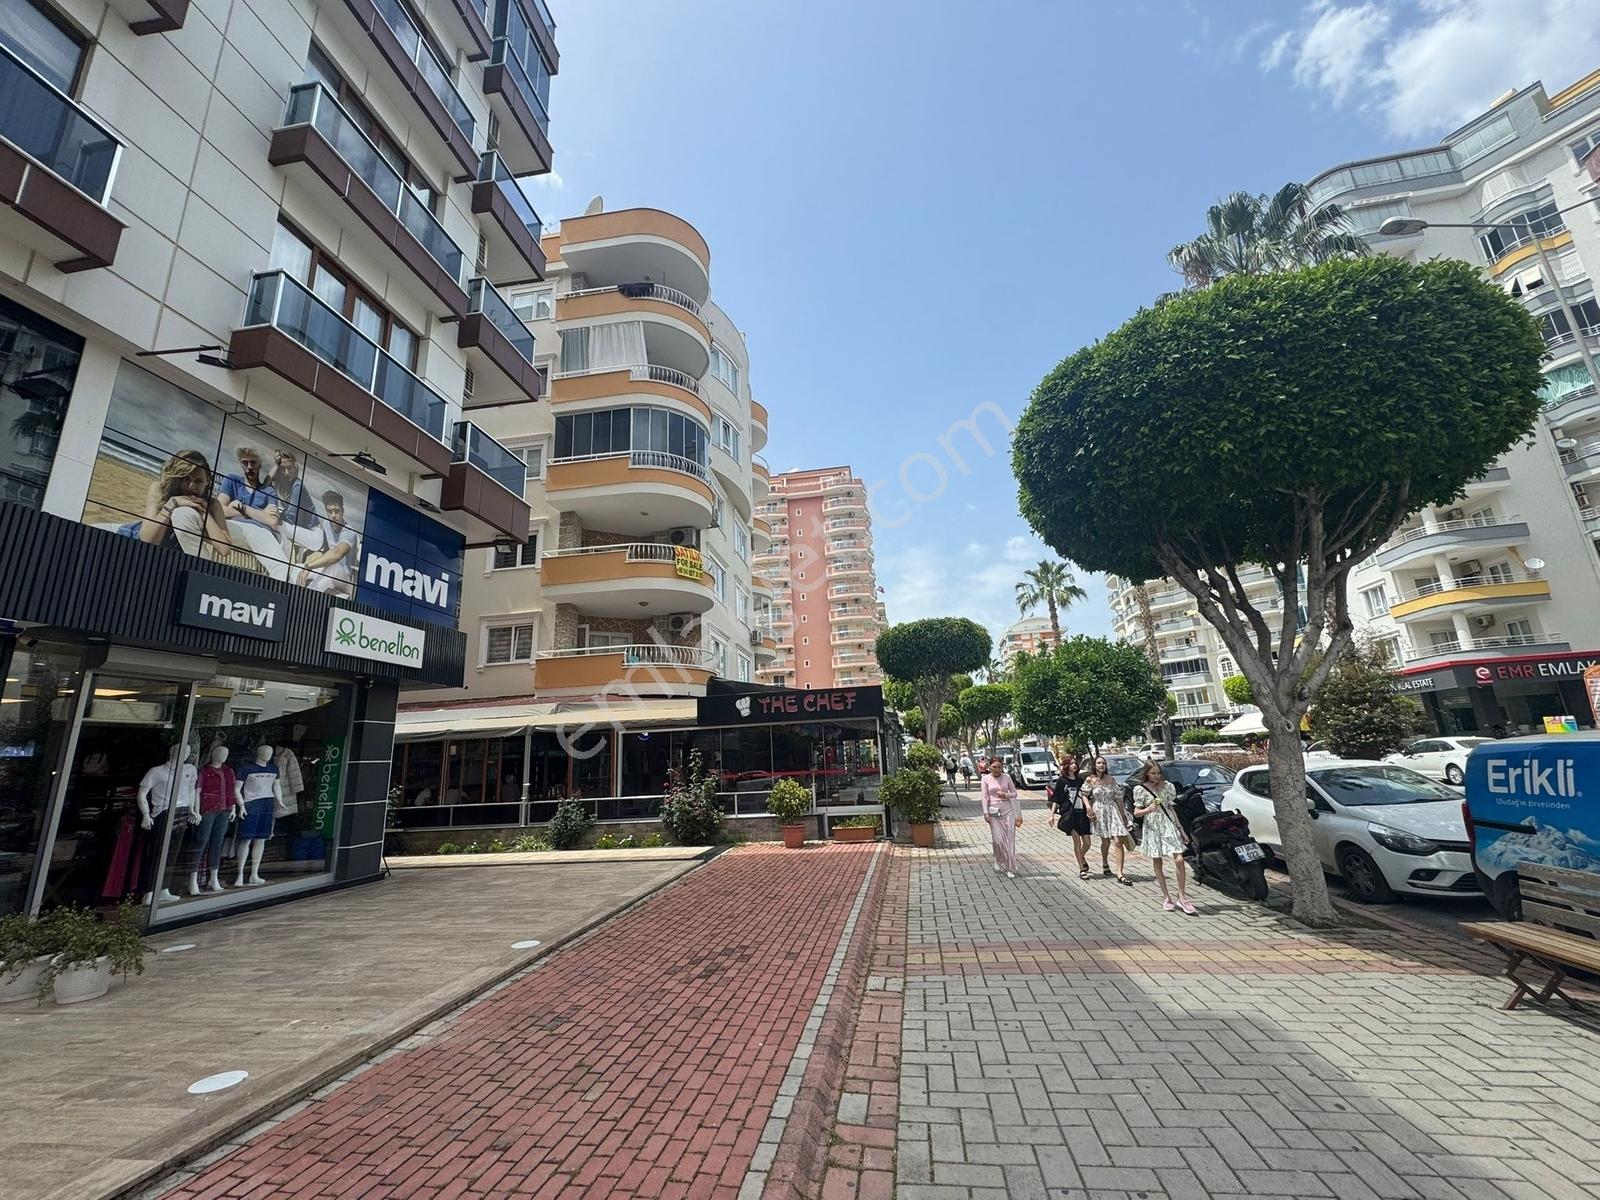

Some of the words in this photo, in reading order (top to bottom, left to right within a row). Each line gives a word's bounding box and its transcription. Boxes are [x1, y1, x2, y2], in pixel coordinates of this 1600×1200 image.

[676, 558, 689, 569] FOR
[689, 561, 703, 571] SALE
[364, 552, 449, 608] mavi
[199, 593, 276, 628] mavi
[358, 621, 420, 660] benetton
[1412, 678, 1433, 689] ESTATE
[1496, 664, 1536, 679] EMR
[757, 694, 798, 714] THE
[803, 691, 857, 712] CHEF
[1487, 759, 1575, 797] Erikli
[315, 763, 338, 830] benetton
[1528, 799, 1571, 809] zirvesinden
